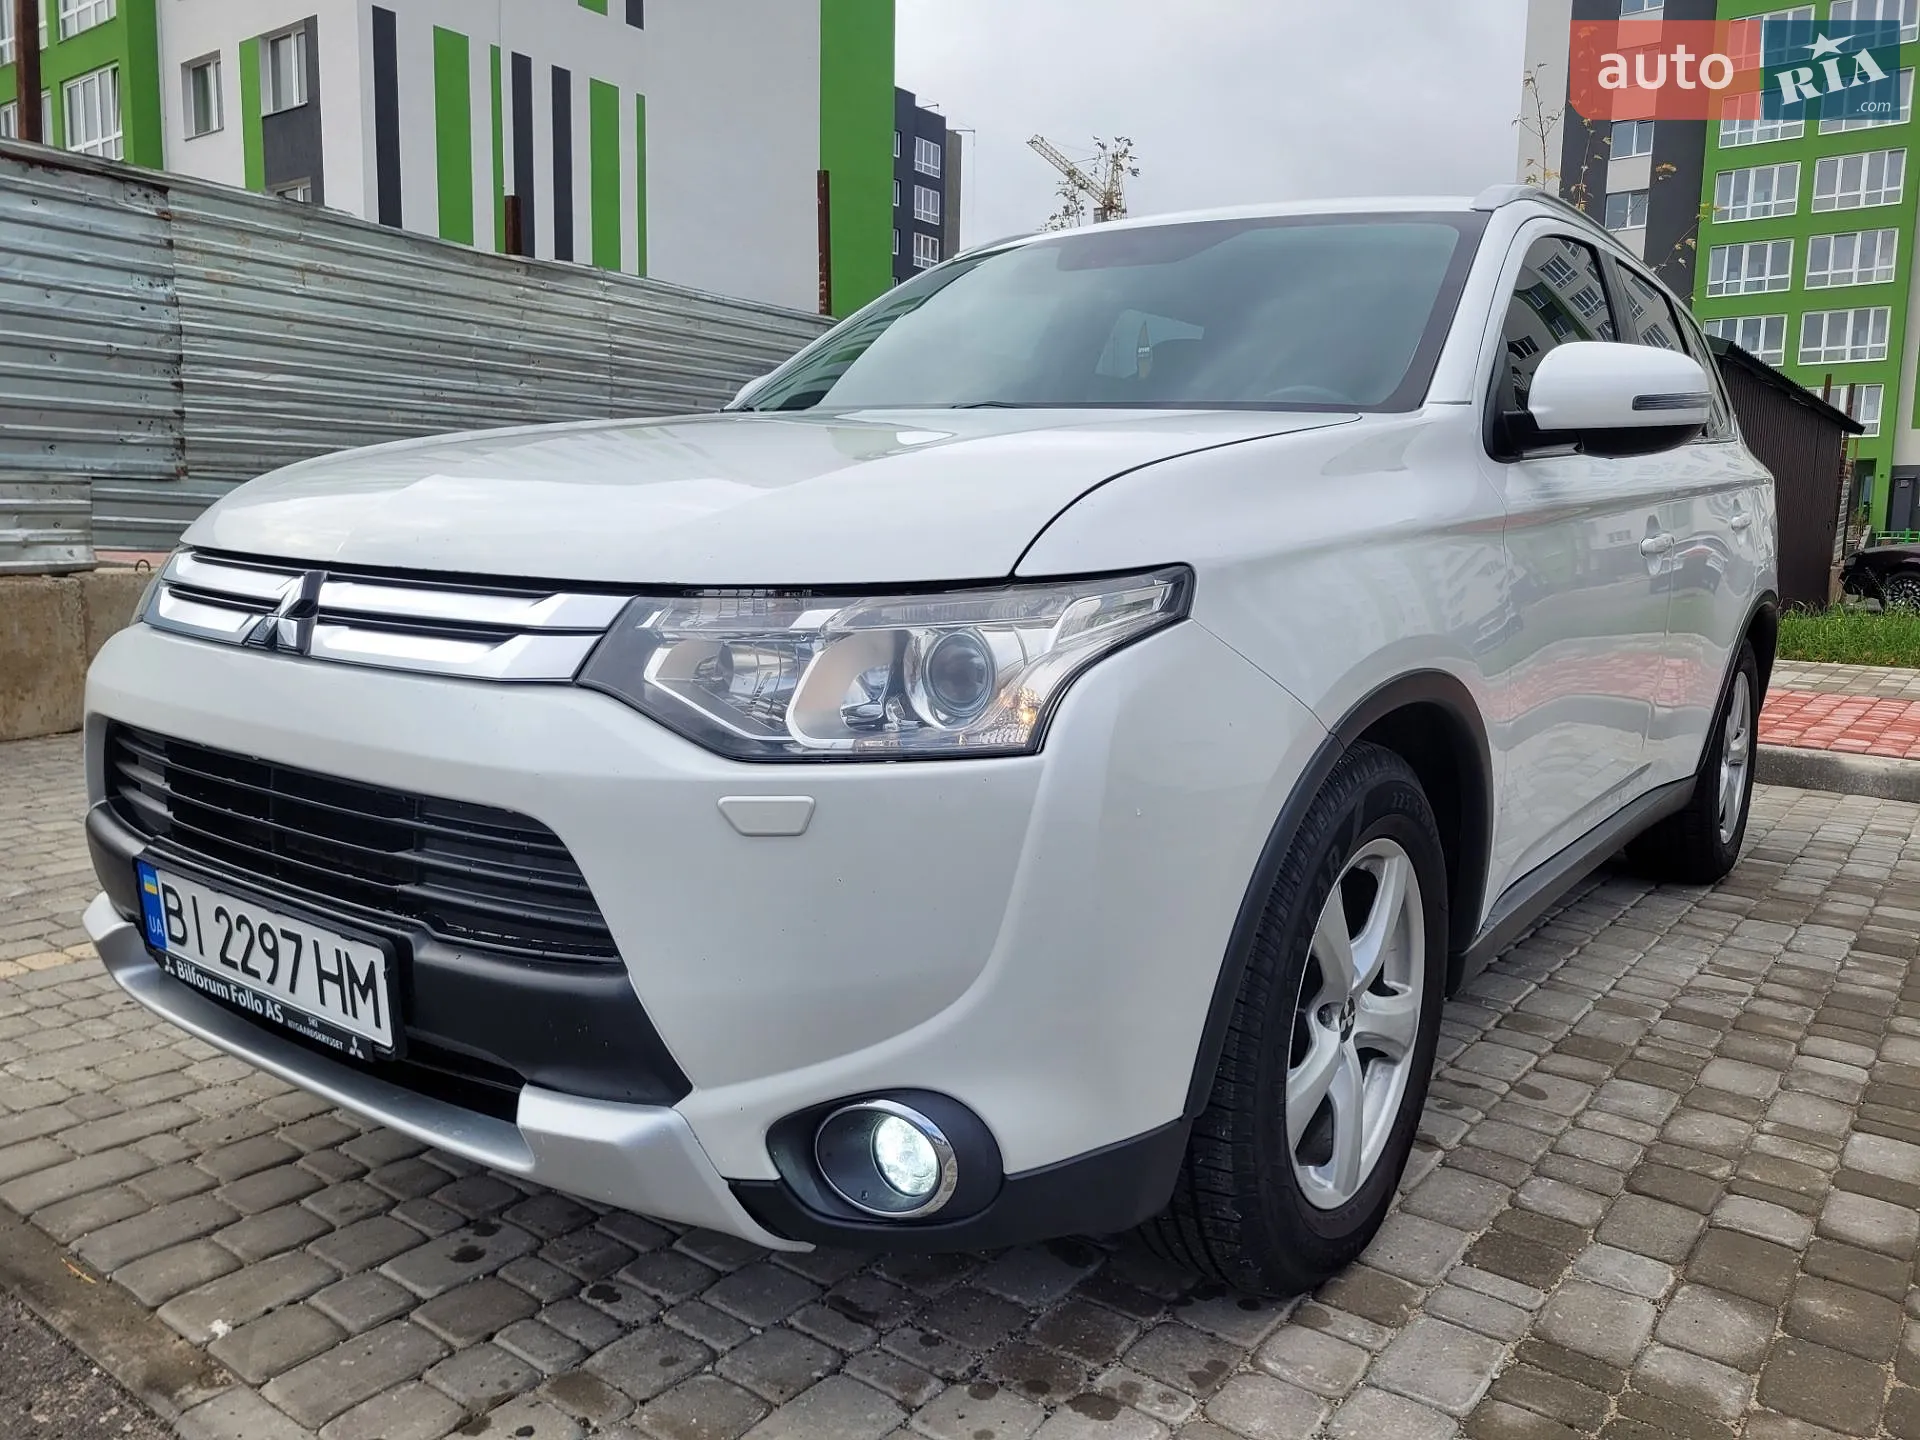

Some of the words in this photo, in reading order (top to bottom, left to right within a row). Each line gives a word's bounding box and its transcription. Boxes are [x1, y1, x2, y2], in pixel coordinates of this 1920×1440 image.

[149, 914, 164, 938] UA
[161, 880, 204, 956] BI
[214, 905, 302, 994] 2297
[313, 939, 382, 1030] HM
[176, 959, 230, 1000] Bilforum
[230, 985, 263, 1015] Follo
[265, 1001, 284, 1025] AS
